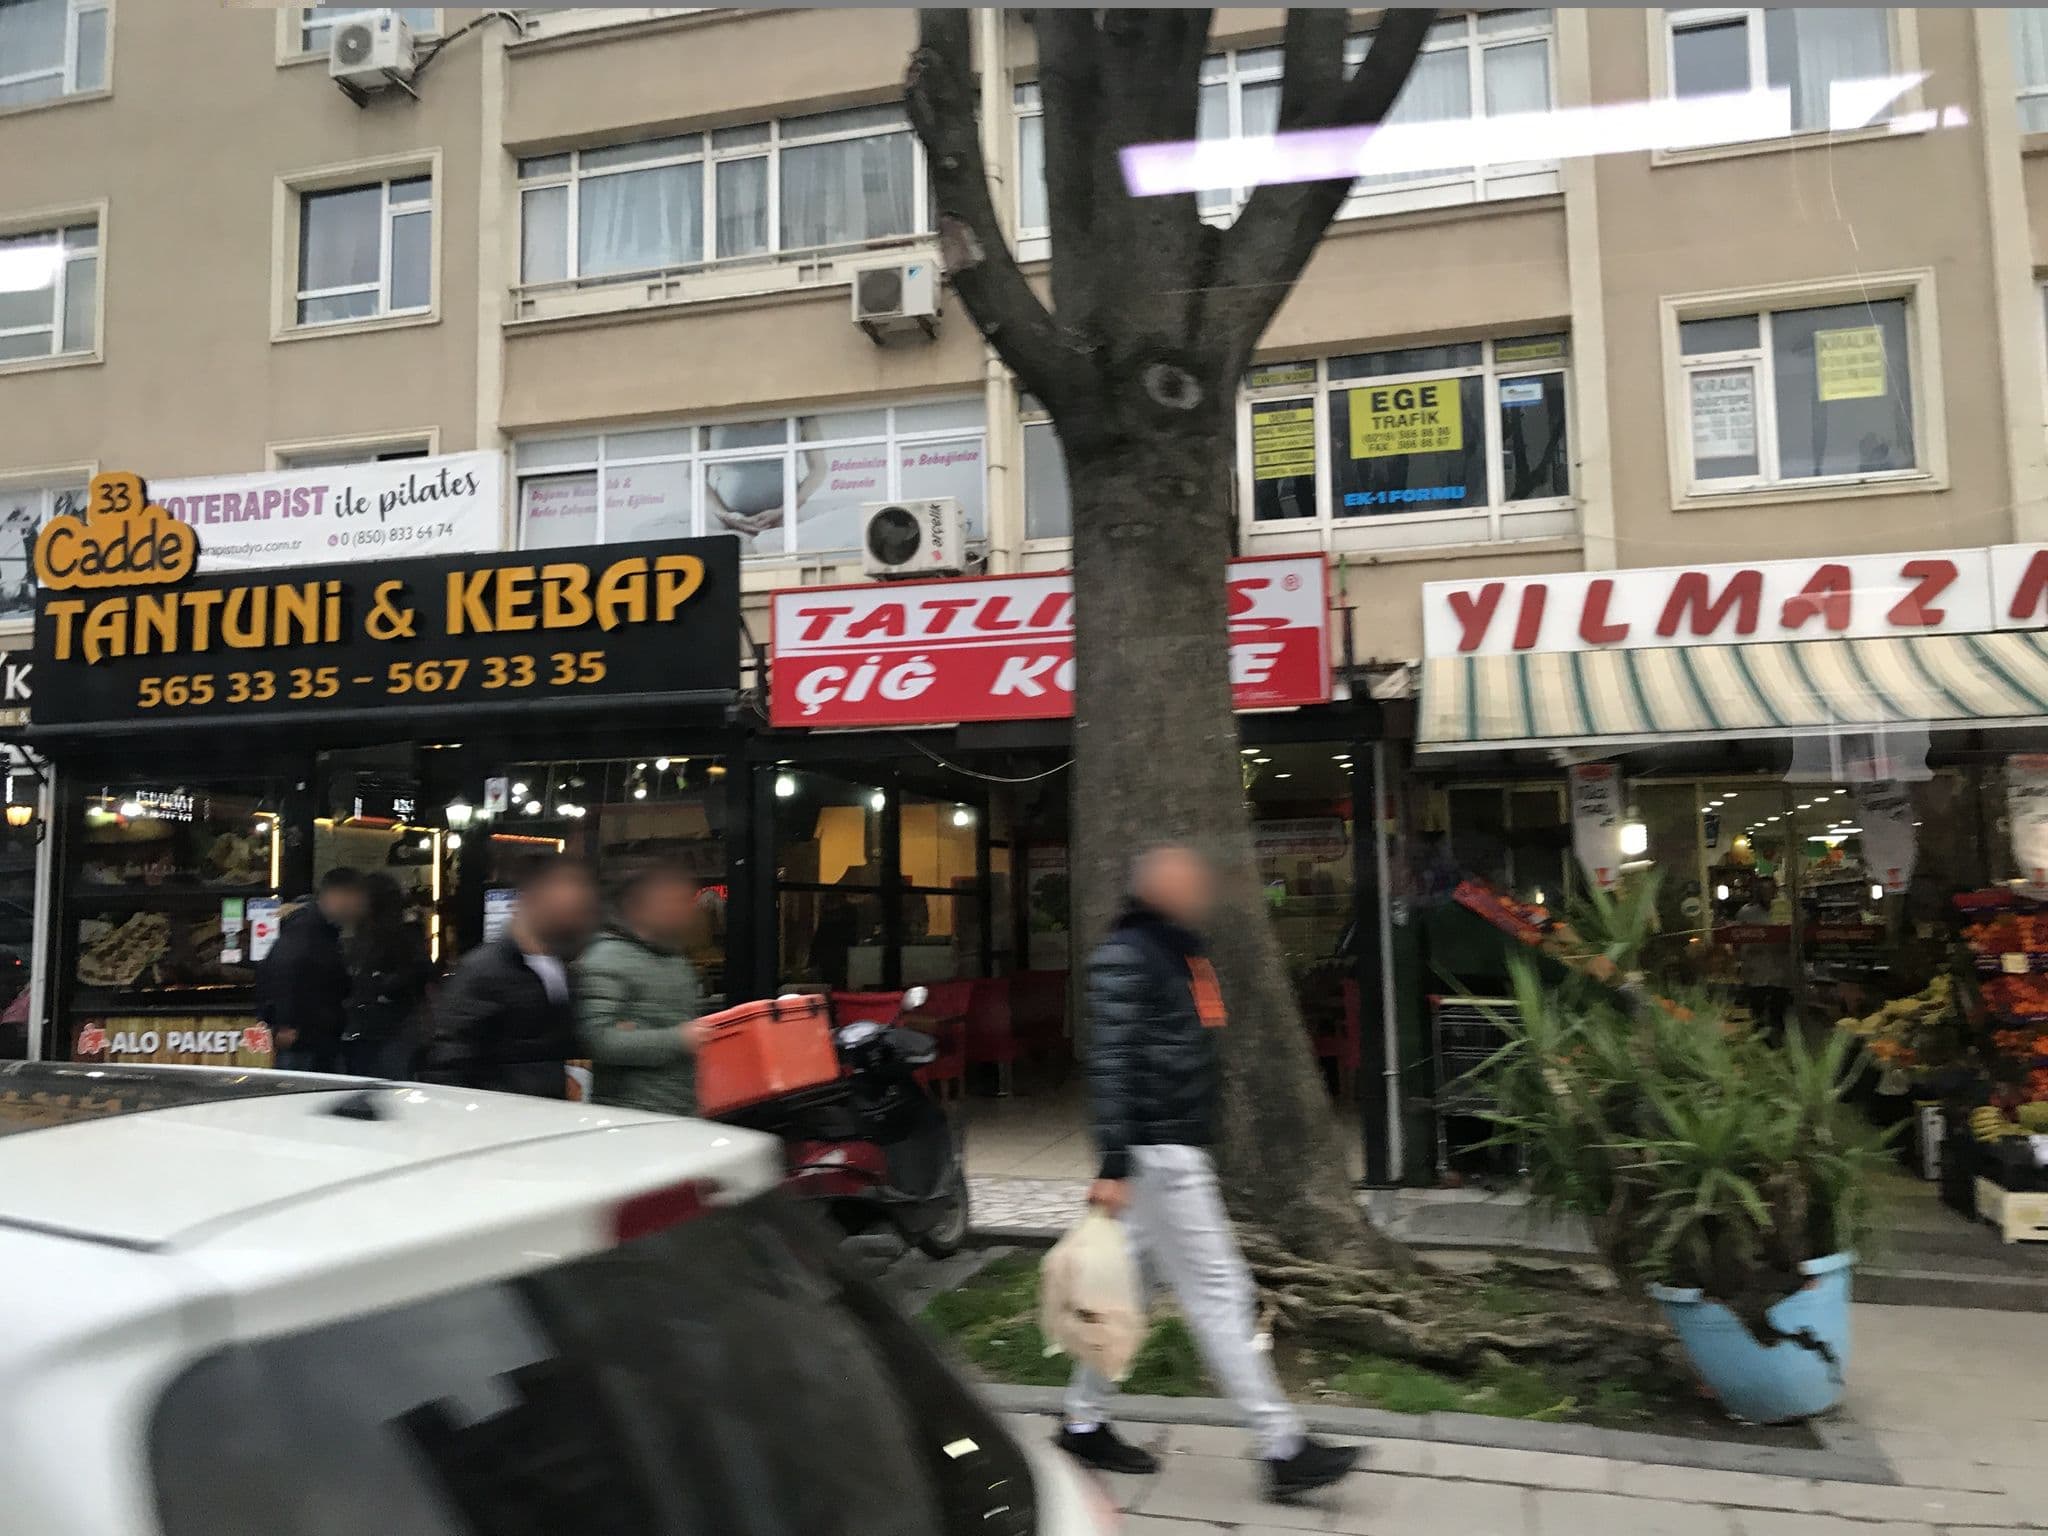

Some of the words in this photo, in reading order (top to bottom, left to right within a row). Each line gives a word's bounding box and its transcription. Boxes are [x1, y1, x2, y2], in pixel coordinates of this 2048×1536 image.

[1371, 386, 1439, 413] EGE
[1371, 410, 1441, 431] TRAFİK
[97, 482, 132, 514] 33
[335, 487, 370, 519] ile
[379, 467, 481, 522] pilates
[46, 518, 183, 577] Cadde
[352, 528, 387, 548] (850)
[389, 527, 413, 542] 833
[436, 522, 454, 538] 74
[928, 503, 944, 548] arçelik
[363, 580, 416, 641] &
[445, 555, 706, 635] KEBAP
[1448, 559, 1958, 651] YILMAZ
[138, 675, 215, 709] 565
[226, 671, 277, 704] 33
[288, 667, 340, 700] 35
[386, 660, 467, 696] 567
[481, 657, 536, 691] 33
[549, 652, 607, 686] 35
[110, 1031, 159, 1055] ALO
[166, 1028, 241, 1054] PAKET
